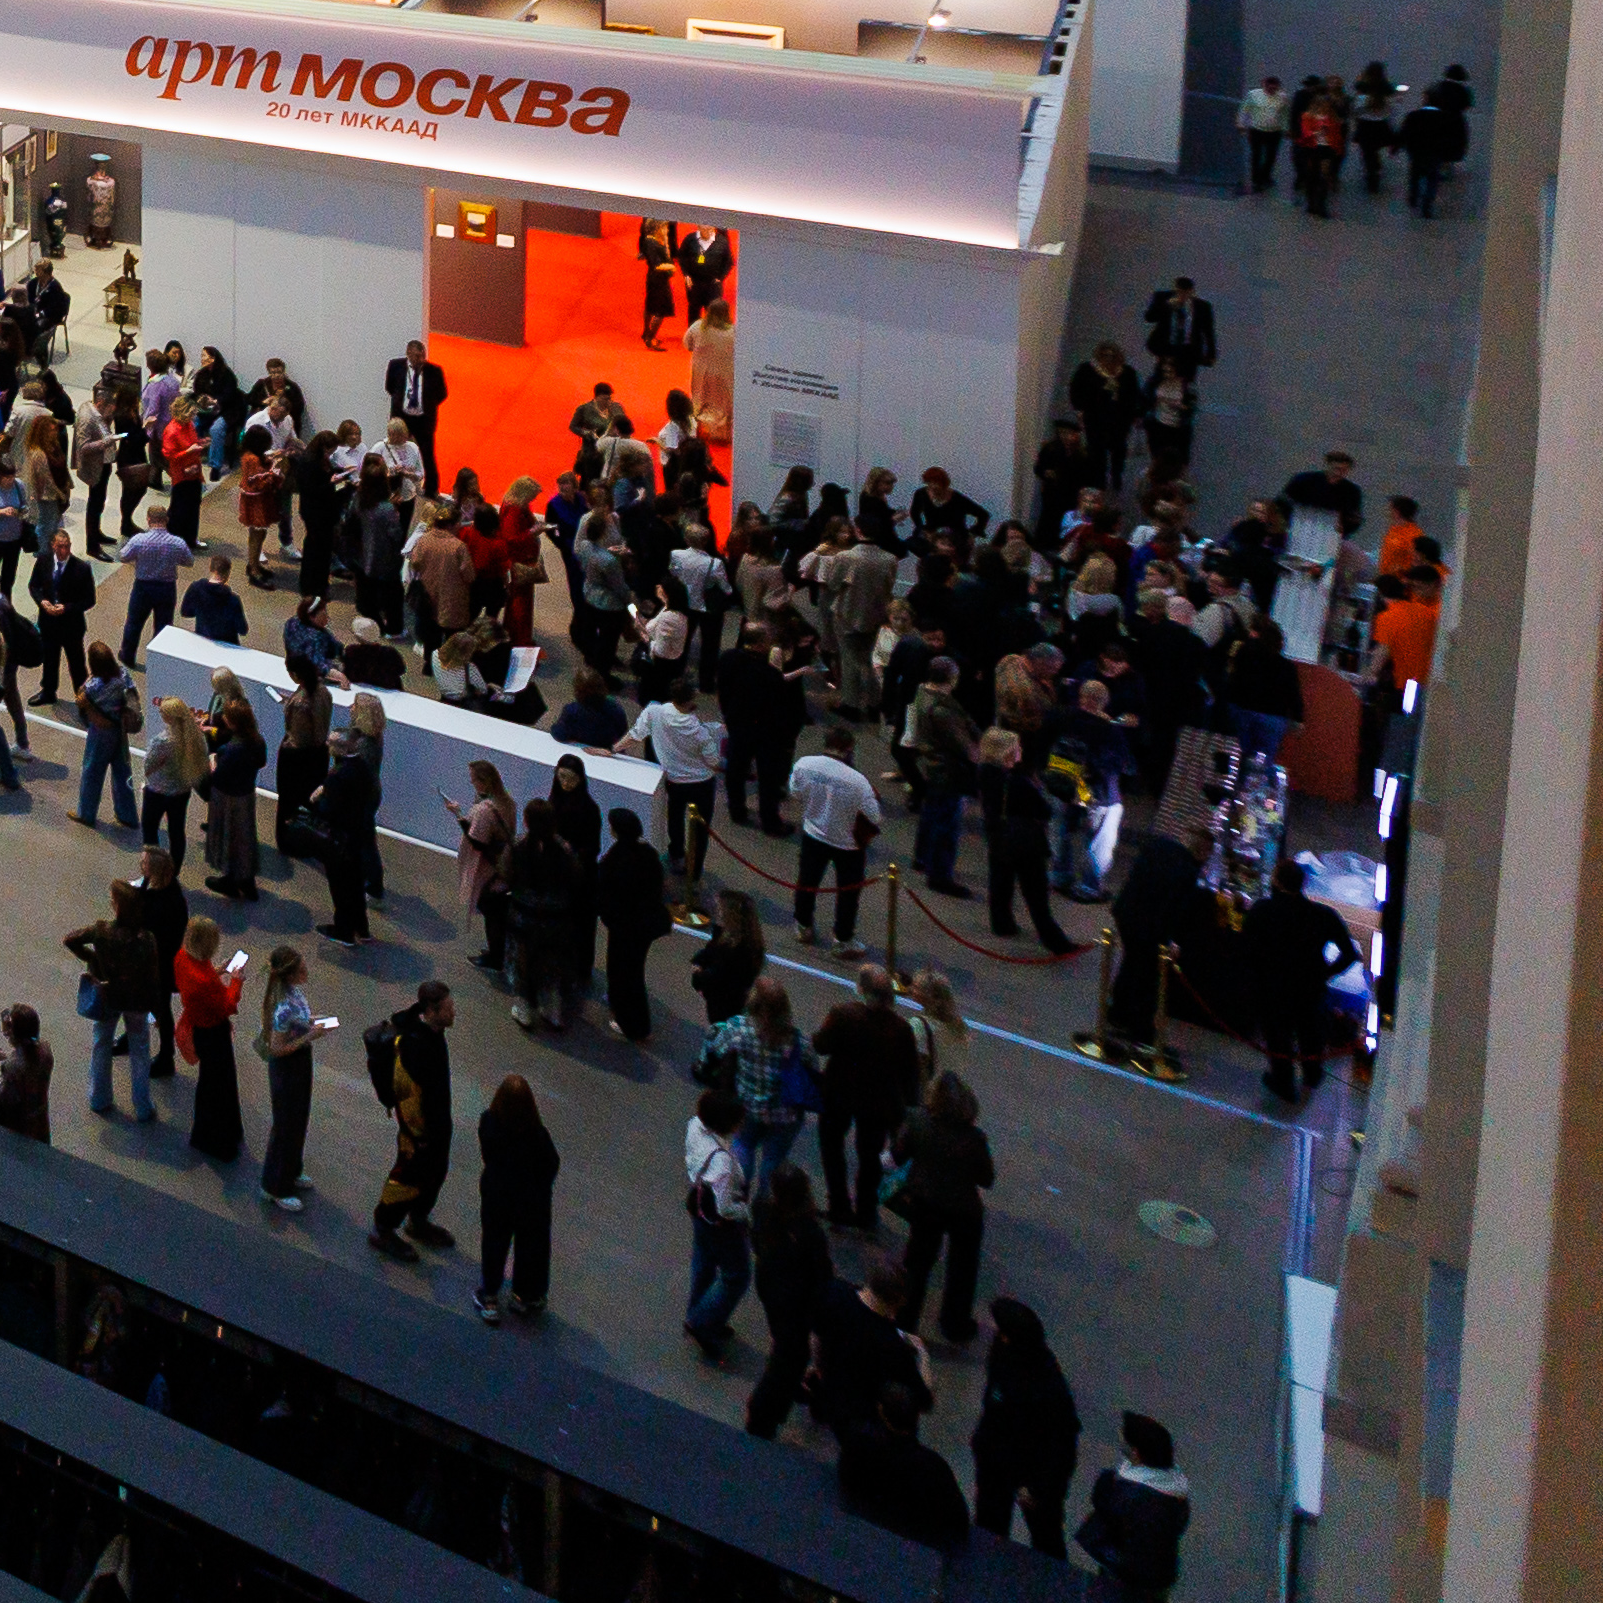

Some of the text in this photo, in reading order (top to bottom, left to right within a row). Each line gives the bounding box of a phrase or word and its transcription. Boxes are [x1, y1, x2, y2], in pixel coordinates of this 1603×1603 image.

[123, 33, 283, 102] арт
[264, 100, 440, 142] 20 лет МККААД
